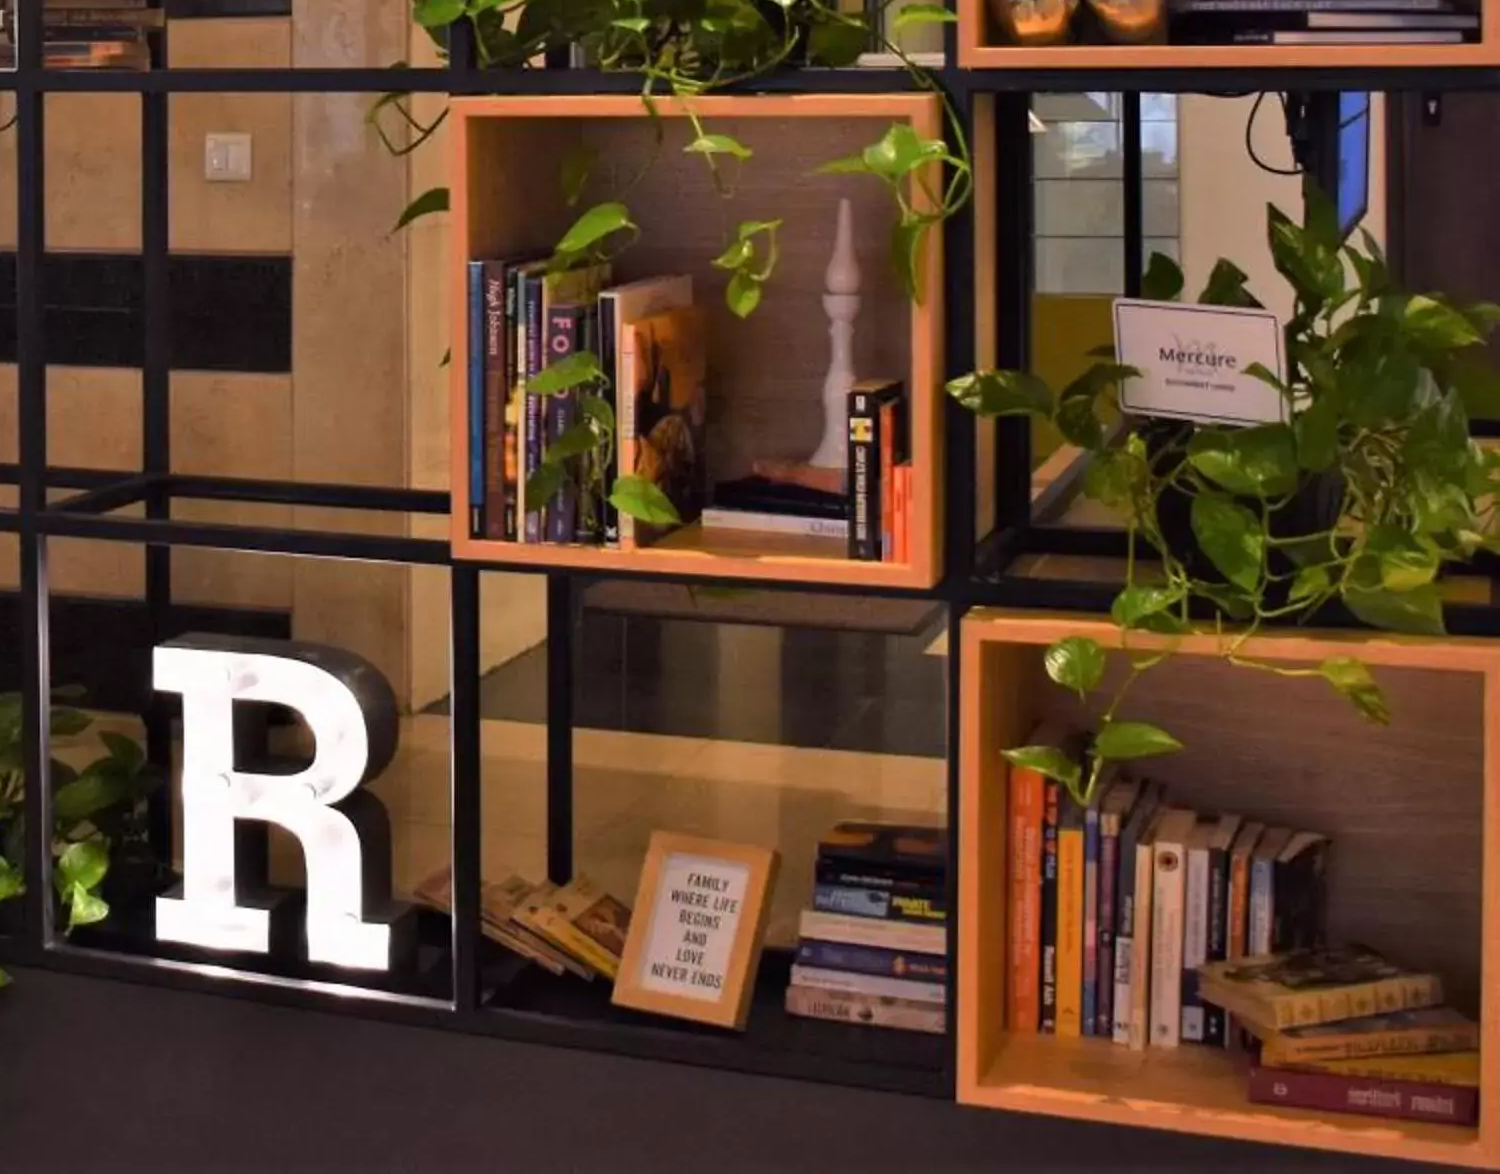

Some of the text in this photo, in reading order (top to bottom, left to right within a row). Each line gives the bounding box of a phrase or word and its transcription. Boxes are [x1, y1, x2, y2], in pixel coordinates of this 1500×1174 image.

[551, 316, 573, 399] FOD
[1158, 347, 1237, 369] Mercure
[153, 645, 390, 971] R
[687, 872, 729, 892] FAMILY
[671, 889, 738, 914] WHERE LIFE
[678, 909, 721, 930] BEGINS
[683, 930, 707, 946] AND
[675, 946, 704, 966] LOVE
[651, 962, 723, 989] NEVER ENDS
